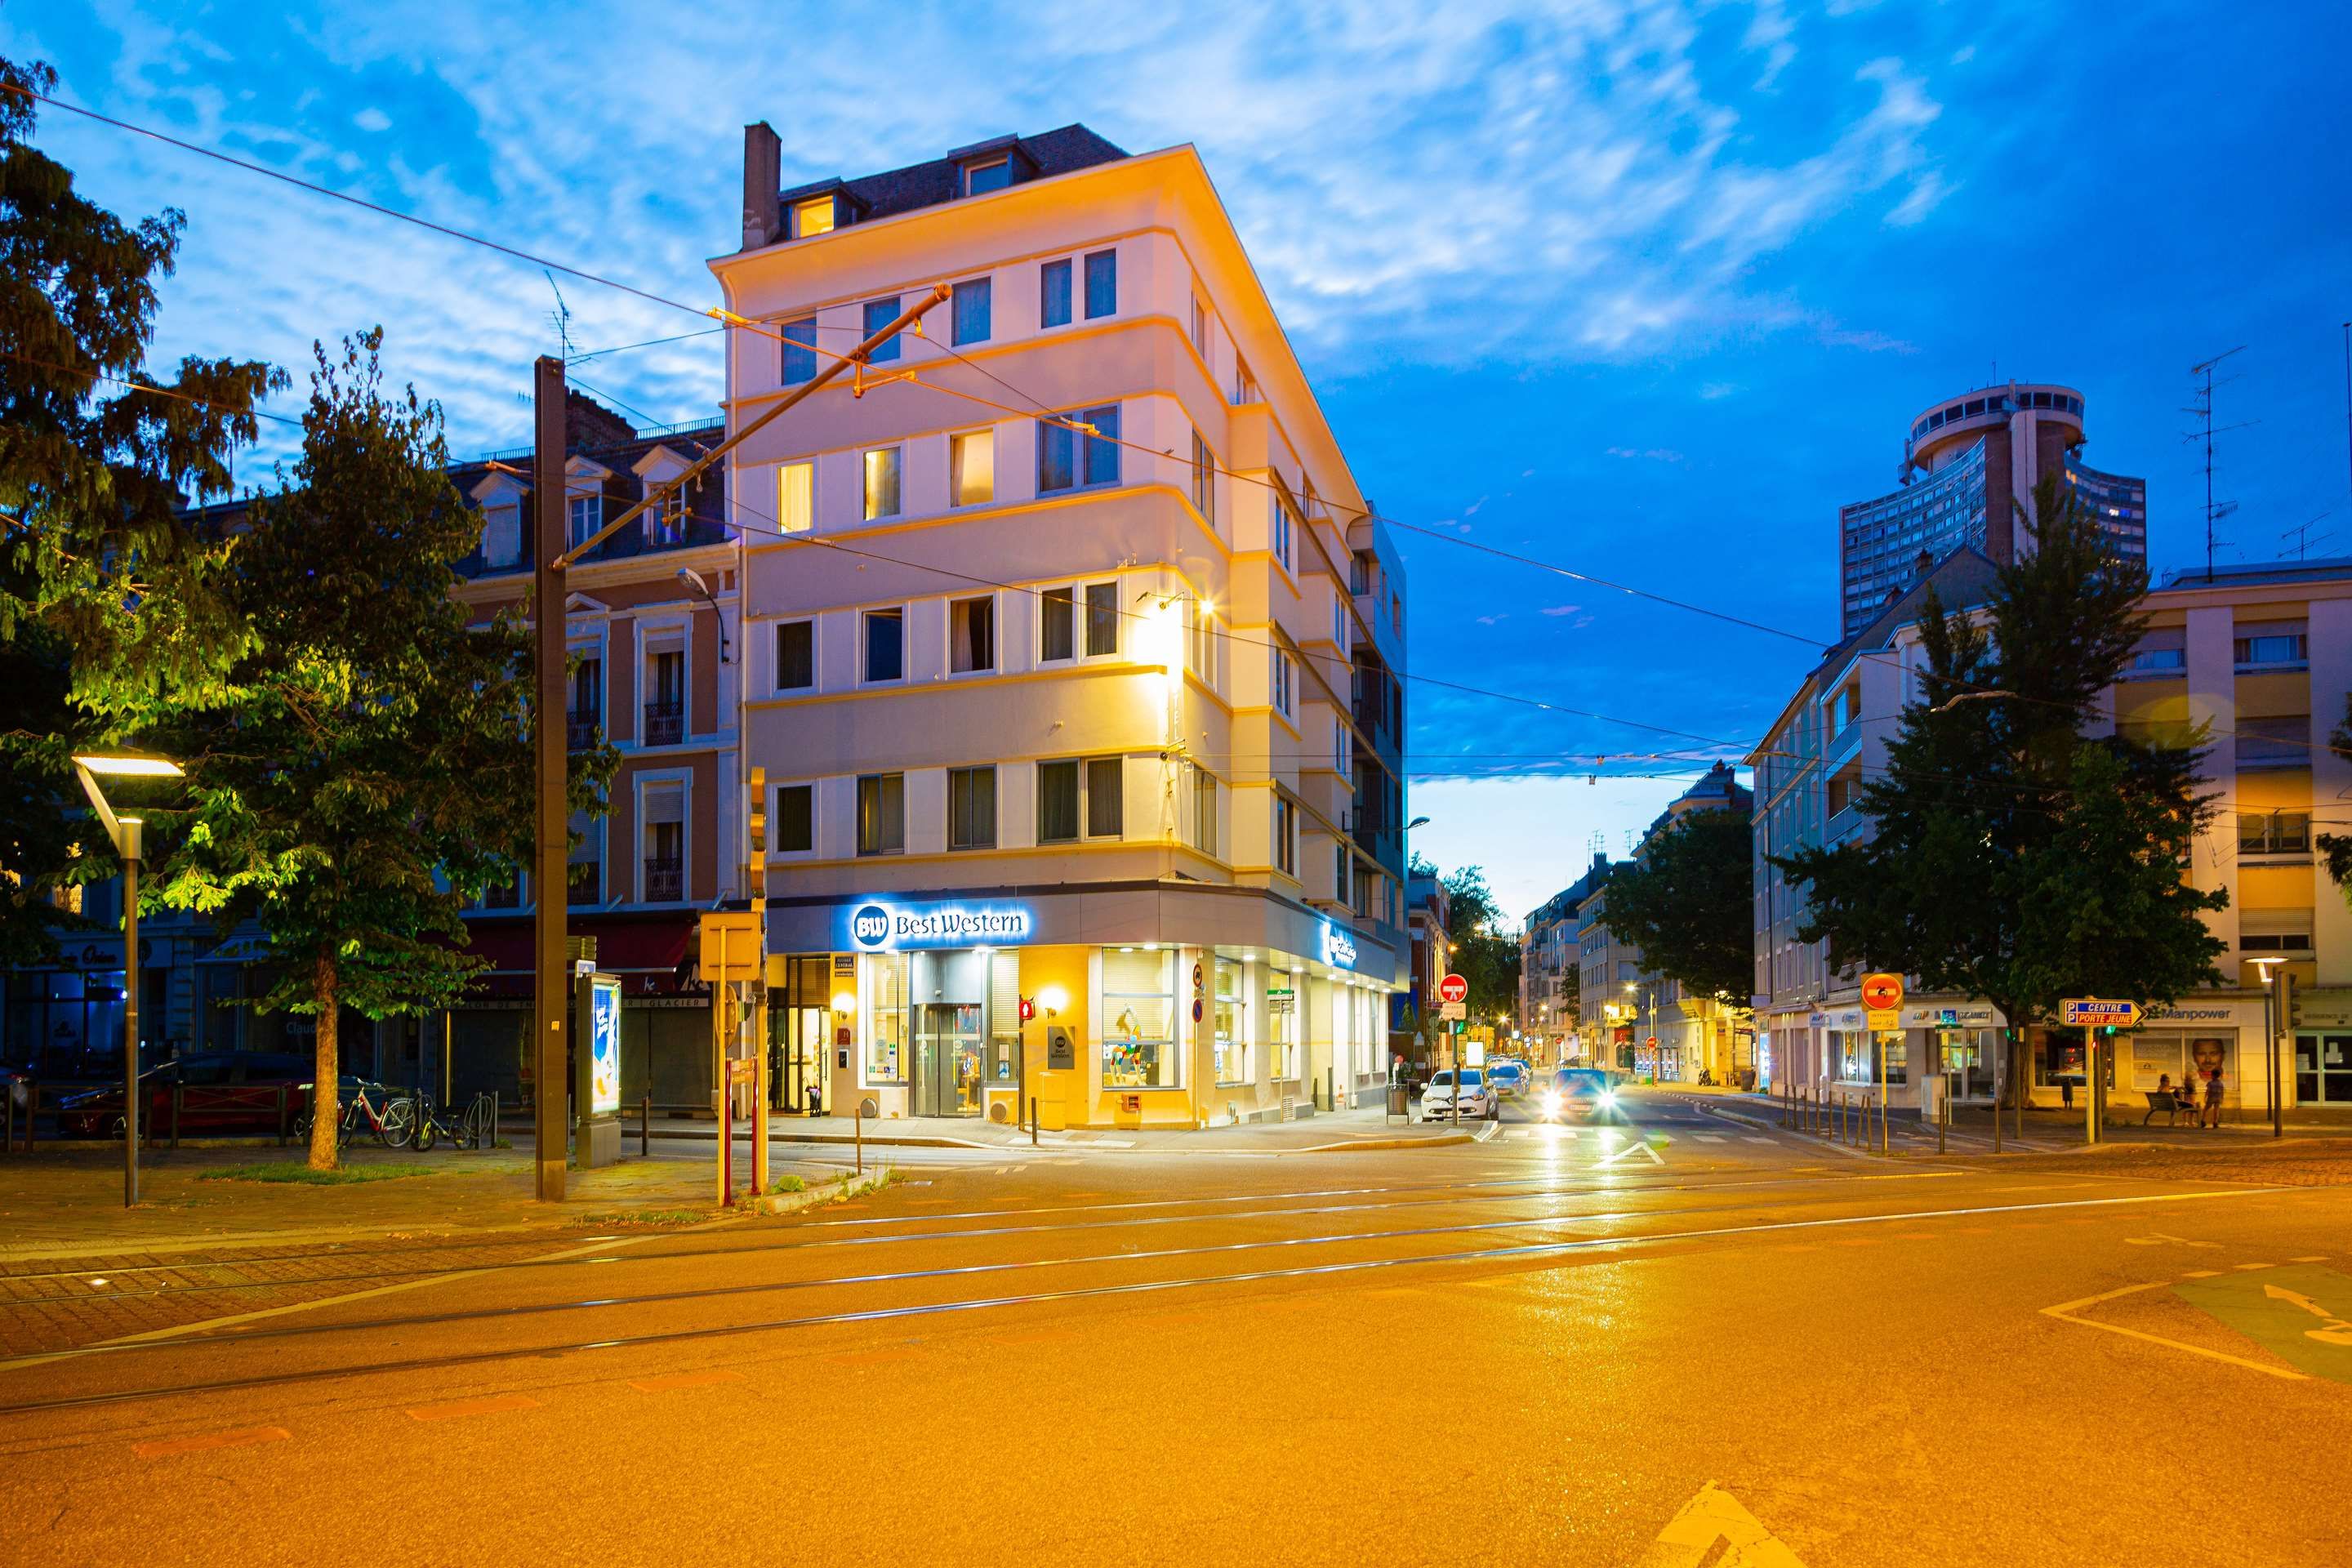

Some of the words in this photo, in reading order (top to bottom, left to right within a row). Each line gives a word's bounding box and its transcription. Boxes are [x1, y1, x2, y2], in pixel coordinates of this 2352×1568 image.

[857, 916, 887, 938] BW
[895, 915, 938, 935] Best
[941, 913, 1023, 934] Western
[648, 999, 700, 1007] GLACIER
[2087, 1003, 2123, 1012] CENTRE
[2079, 1013, 2106, 1023] PORTE
[2106, 1013, 2132, 1023] JEUNE
[2161, 1008, 2231, 1021] Manpower
[286, 1021, 316, 1034] Claud
